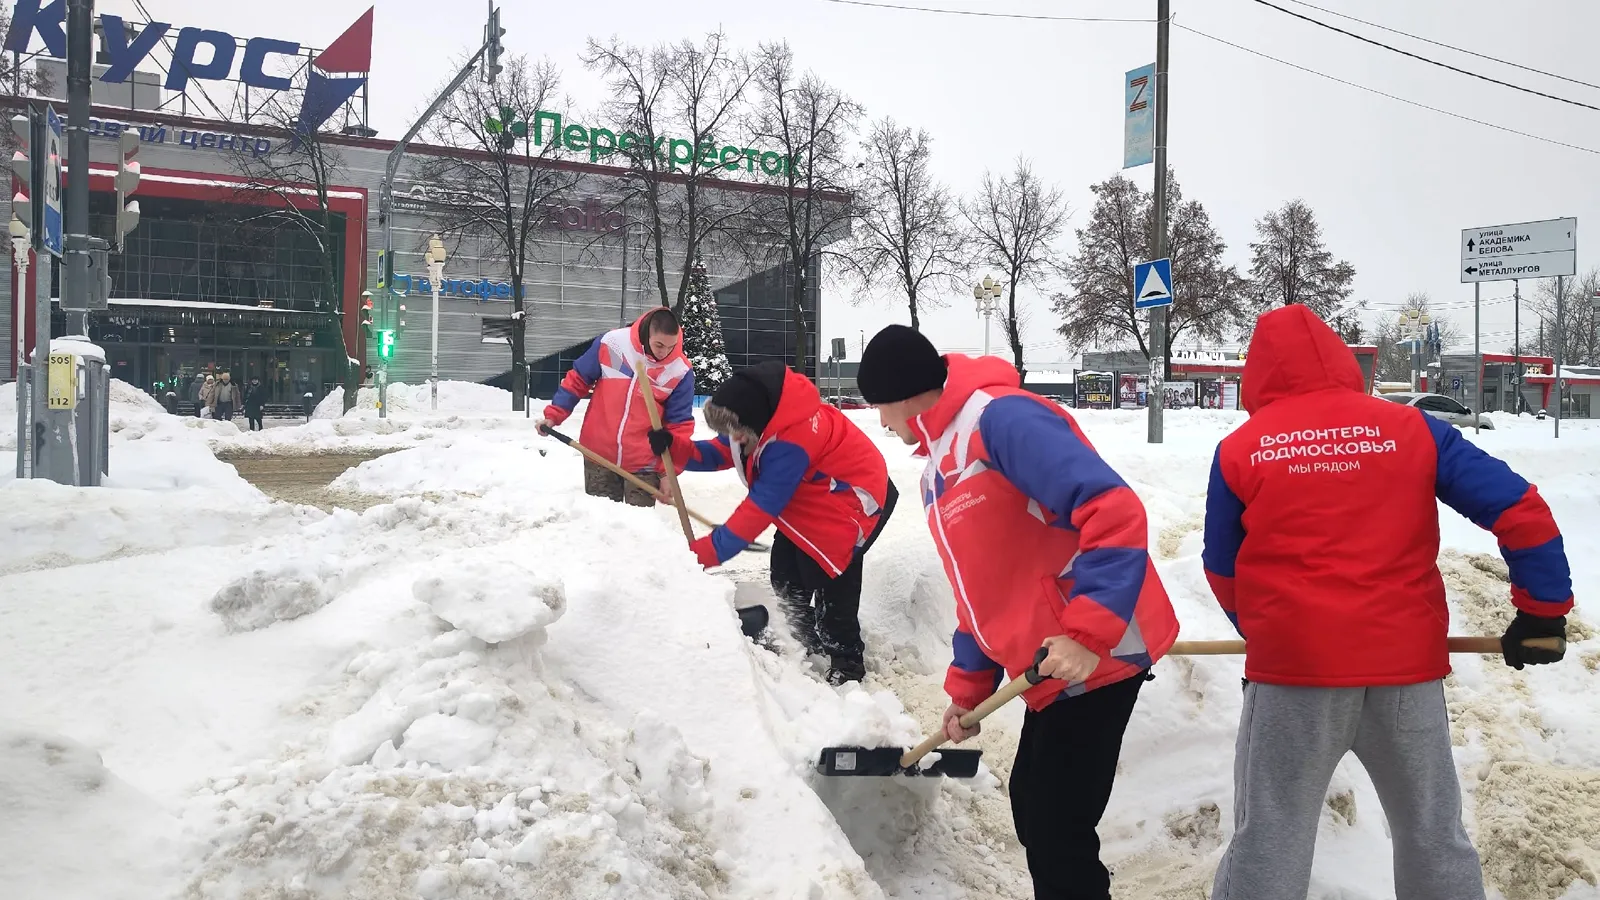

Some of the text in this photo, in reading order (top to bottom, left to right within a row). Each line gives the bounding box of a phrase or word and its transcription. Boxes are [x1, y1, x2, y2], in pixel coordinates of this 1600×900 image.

[1129, 75, 1148, 112] Z
[1479, 229, 1504, 238] улица
[1479, 234, 1531, 246] АКАДЕМИКА
[1479, 245, 1514, 255] БЕЛОВА
[1479, 260, 1503, 269] улица
[1479, 265, 1540, 276] МЕТАЛЛУРГОВ
[50, 356, 70, 365] SOS
[50, 397, 69, 406] 112
[1086, 393, 1111, 403] ЦВЕТЫ
[1259, 425, 1381, 448] ВОЛОНТЕРЫ
[1250, 440, 1397, 467] ПОДМОСКОВЬЯ
[1288, 460, 1361, 475] МЫ РЯДОМ
